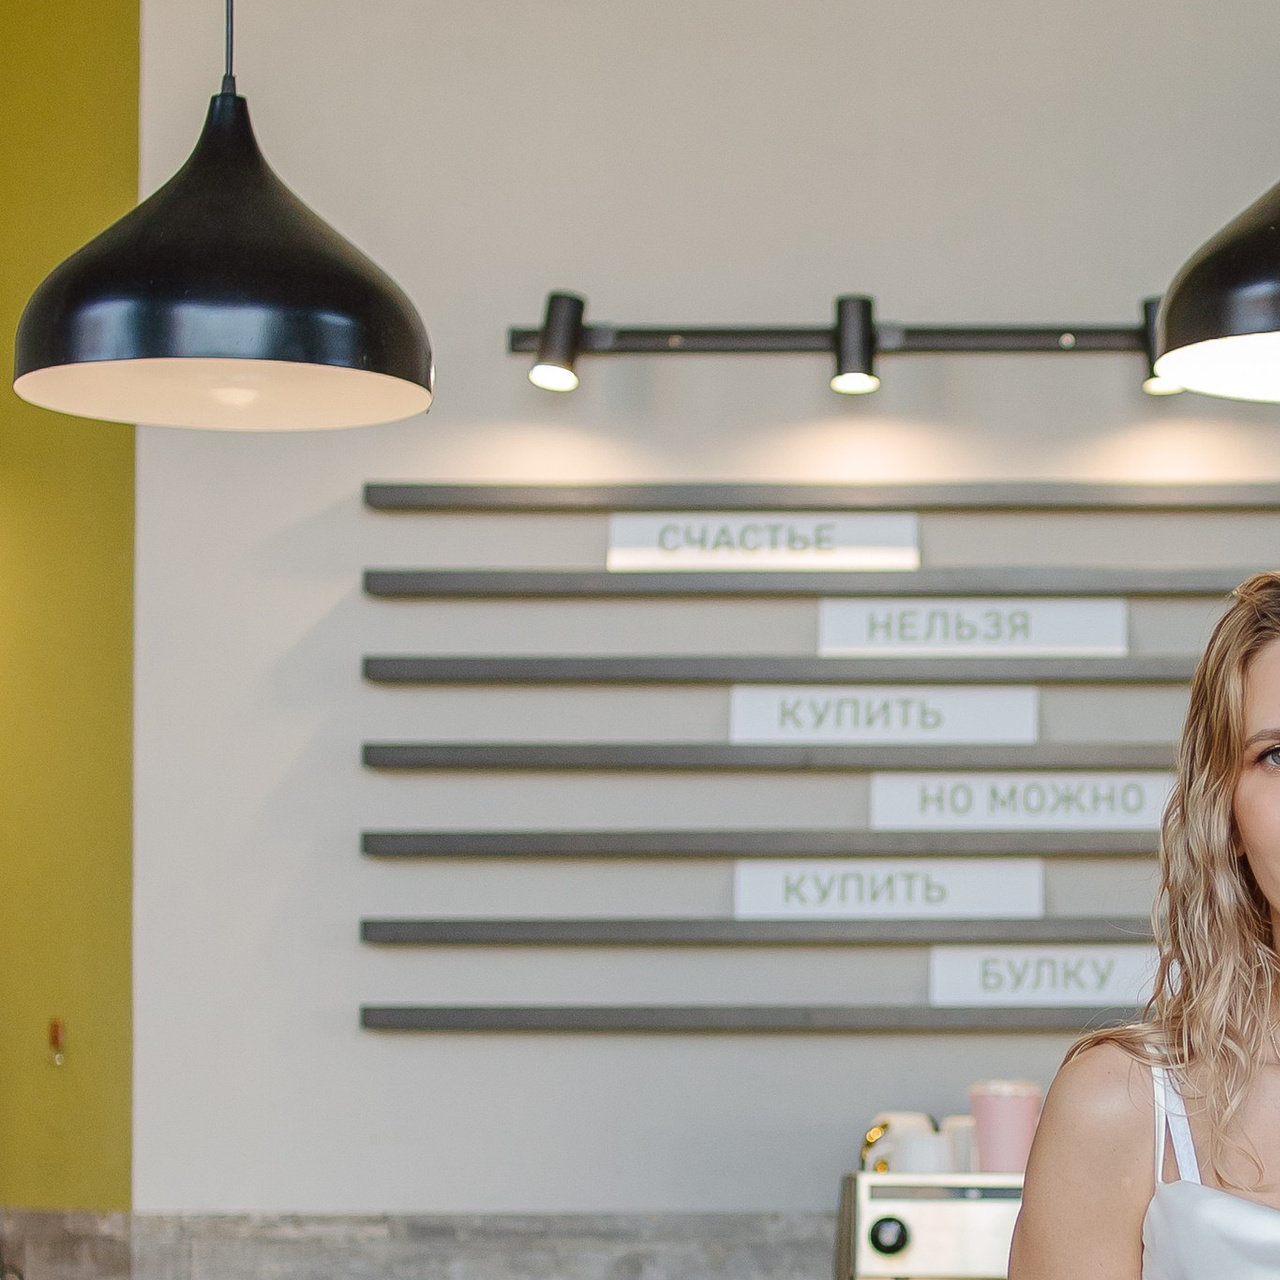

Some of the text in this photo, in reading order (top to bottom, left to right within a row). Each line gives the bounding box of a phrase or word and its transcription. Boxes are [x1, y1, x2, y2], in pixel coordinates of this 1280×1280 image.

[657, 522, 837, 553] СЧАСТЬЕ
[867, 611, 1032, 642] НЕЛЬЗЯ
[779, 698, 944, 729] КУПИТЬ
[919, 784, 1146, 815] НО МОЖНО
[782, 873, 948, 905] КУПИТЬ
[979, 958, 1115, 991] БУЛКУ
